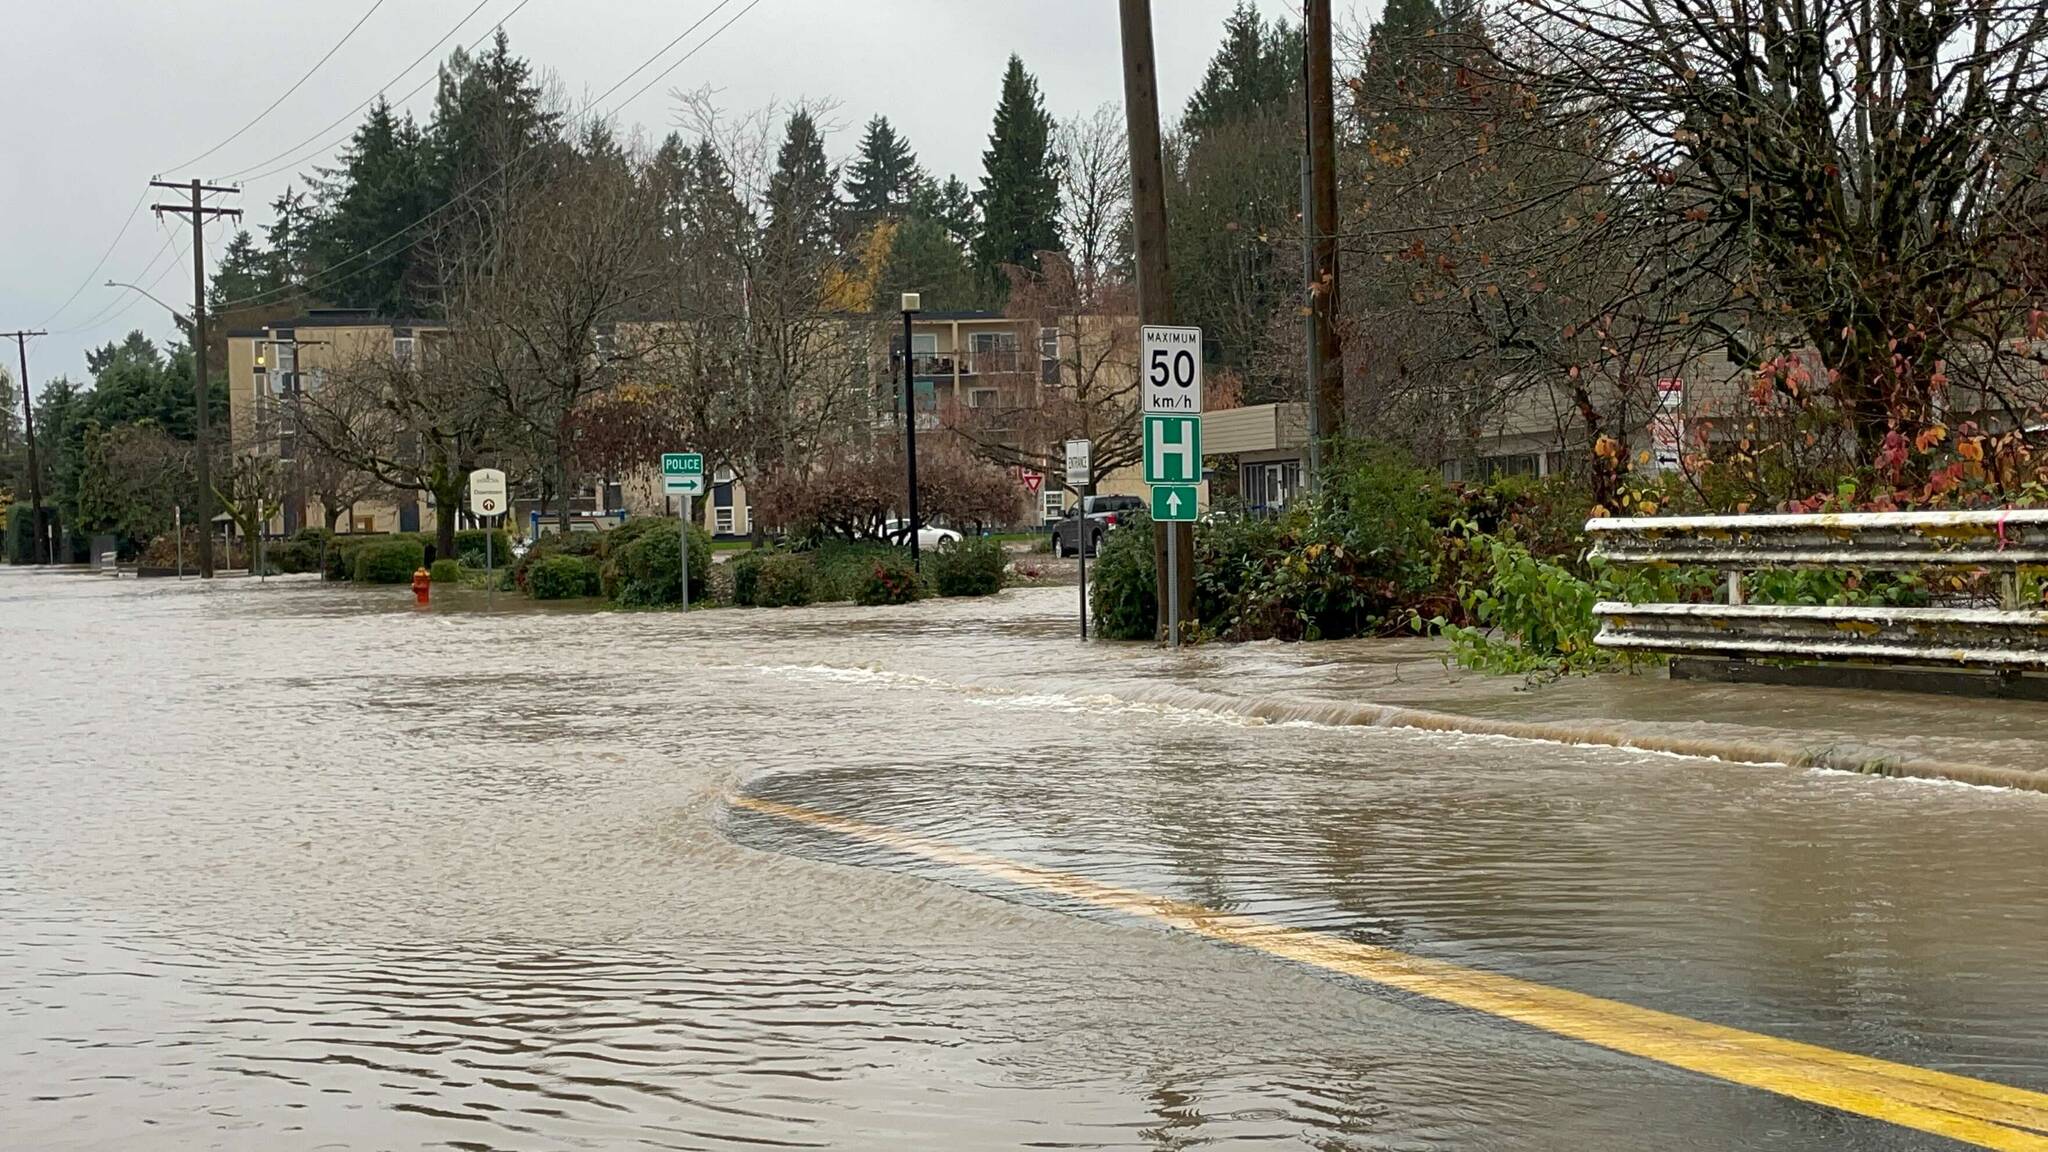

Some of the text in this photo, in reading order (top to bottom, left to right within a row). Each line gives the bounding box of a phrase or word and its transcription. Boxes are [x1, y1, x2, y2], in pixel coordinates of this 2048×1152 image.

[1147, 332, 1196, 344] MAXIMUM
[1150, 350, 1195, 388] 50
[1153, 394, 1192, 409] km/h
[1152, 420, 1193, 479] H
[666, 459, 700, 470] POLICE
[1068, 456, 1087, 470] ENTRANCE
